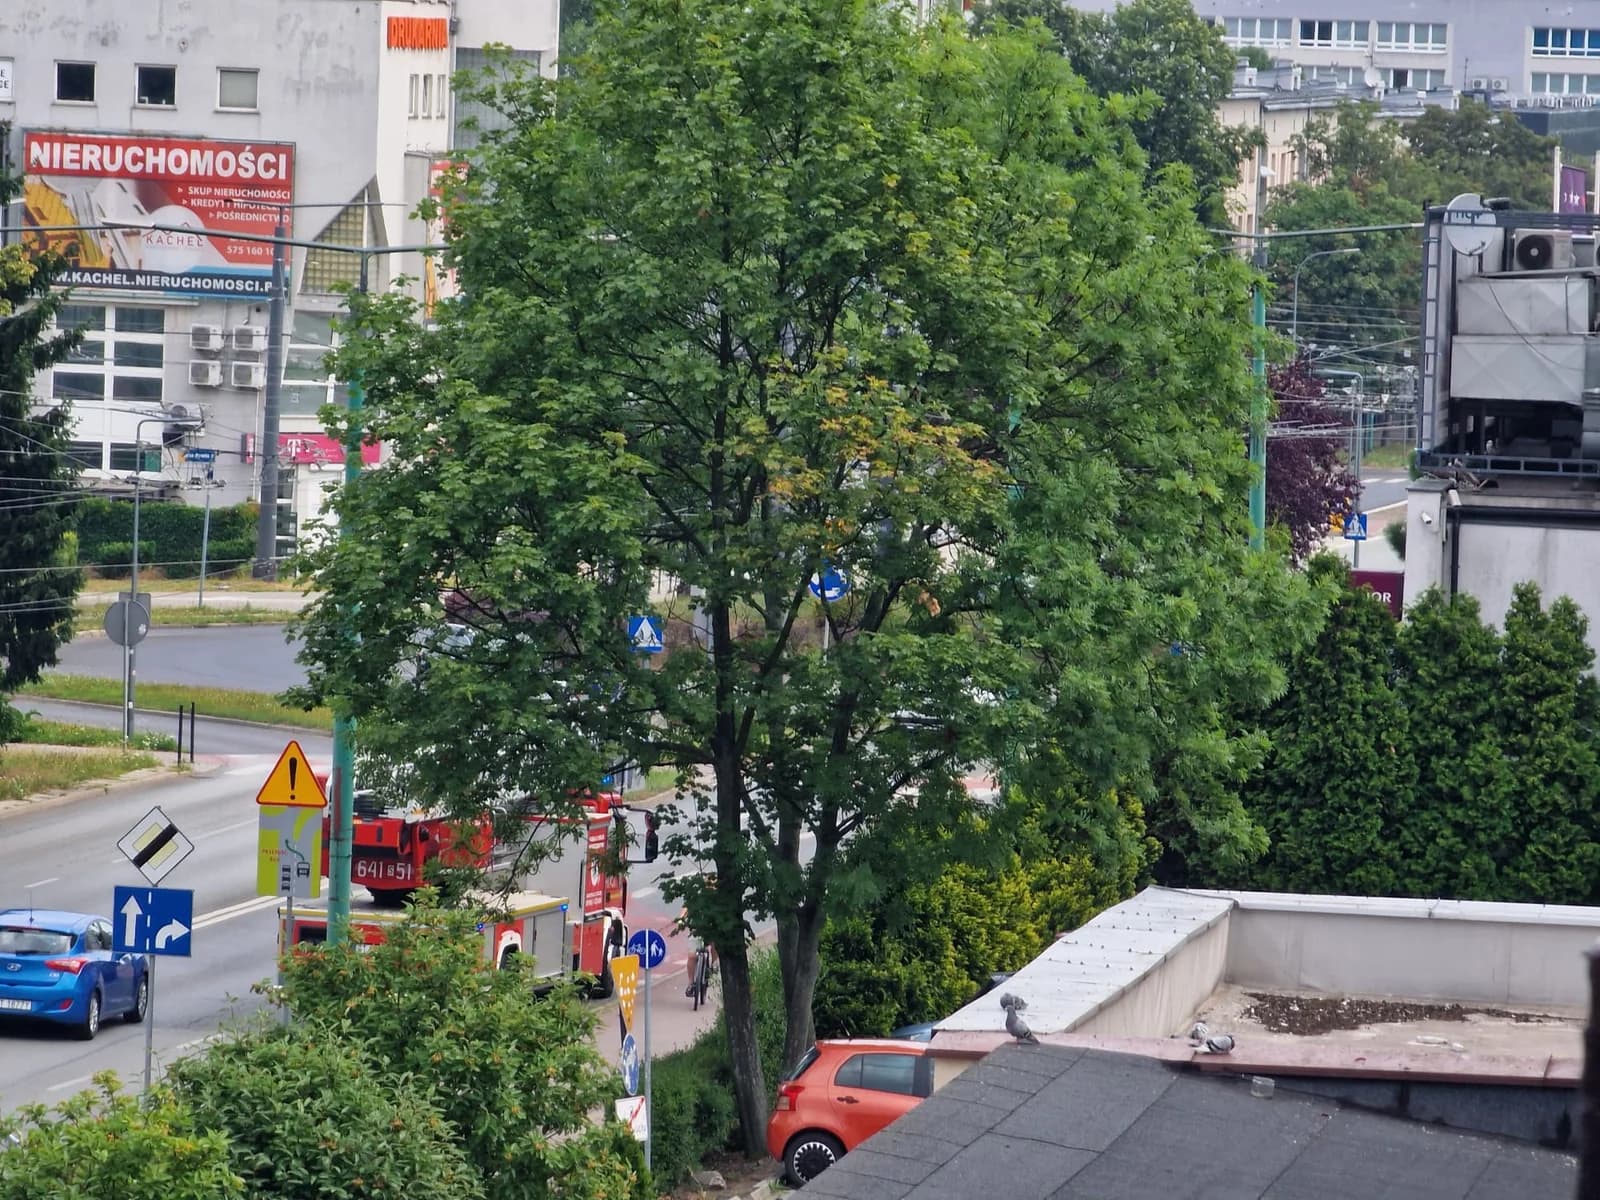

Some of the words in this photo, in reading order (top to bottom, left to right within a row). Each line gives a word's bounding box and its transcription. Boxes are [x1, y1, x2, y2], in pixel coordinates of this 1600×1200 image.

[30, 141, 286, 180] NIERUCHOMOŚCI
[188, 186, 212, 195] SKUP
[214, 187, 290, 199] NIERUCHOMOŚCI
[146, 234, 204, 247] KACHEL
[227, 246, 243, 254] 575
[247, 246, 262, 255] 160
[357, 860, 383, 879] 641
[396, 863, 411, 881] 51
